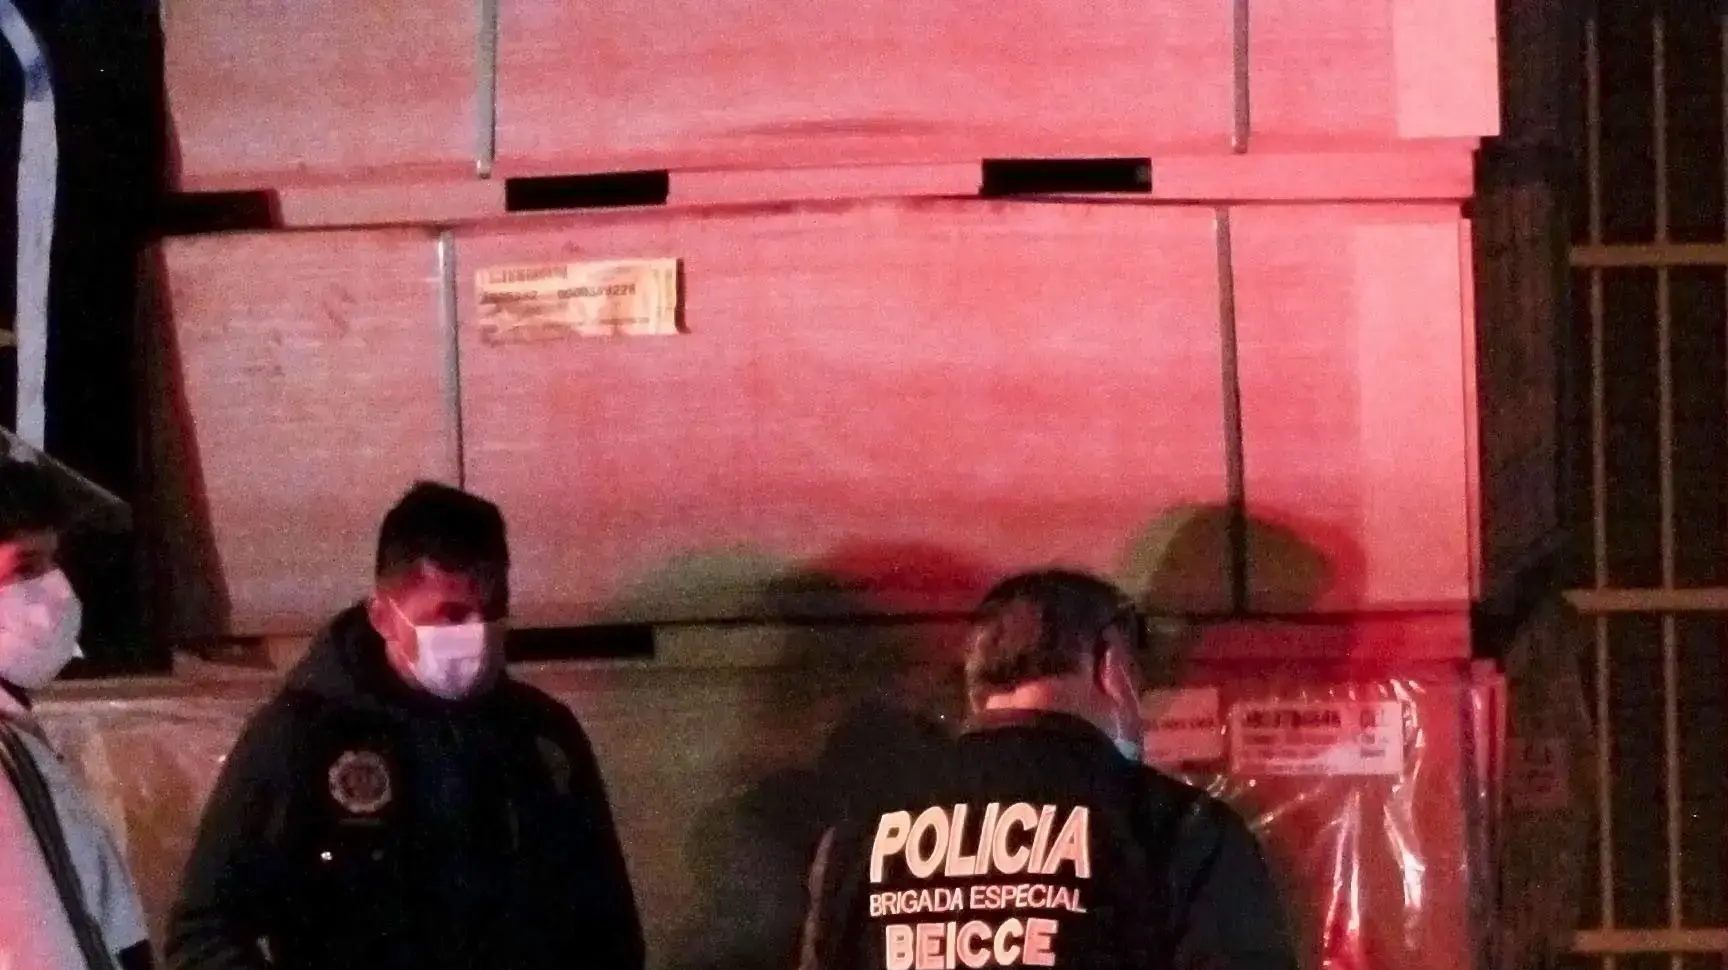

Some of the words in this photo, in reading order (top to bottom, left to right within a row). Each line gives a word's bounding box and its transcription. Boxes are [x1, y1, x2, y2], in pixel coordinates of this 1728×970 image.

[869, 802, 1091, 883] POLICIA
[869, 887, 964, 917] BRIGADA
[969, 884, 1088, 913] ESPECIAL
